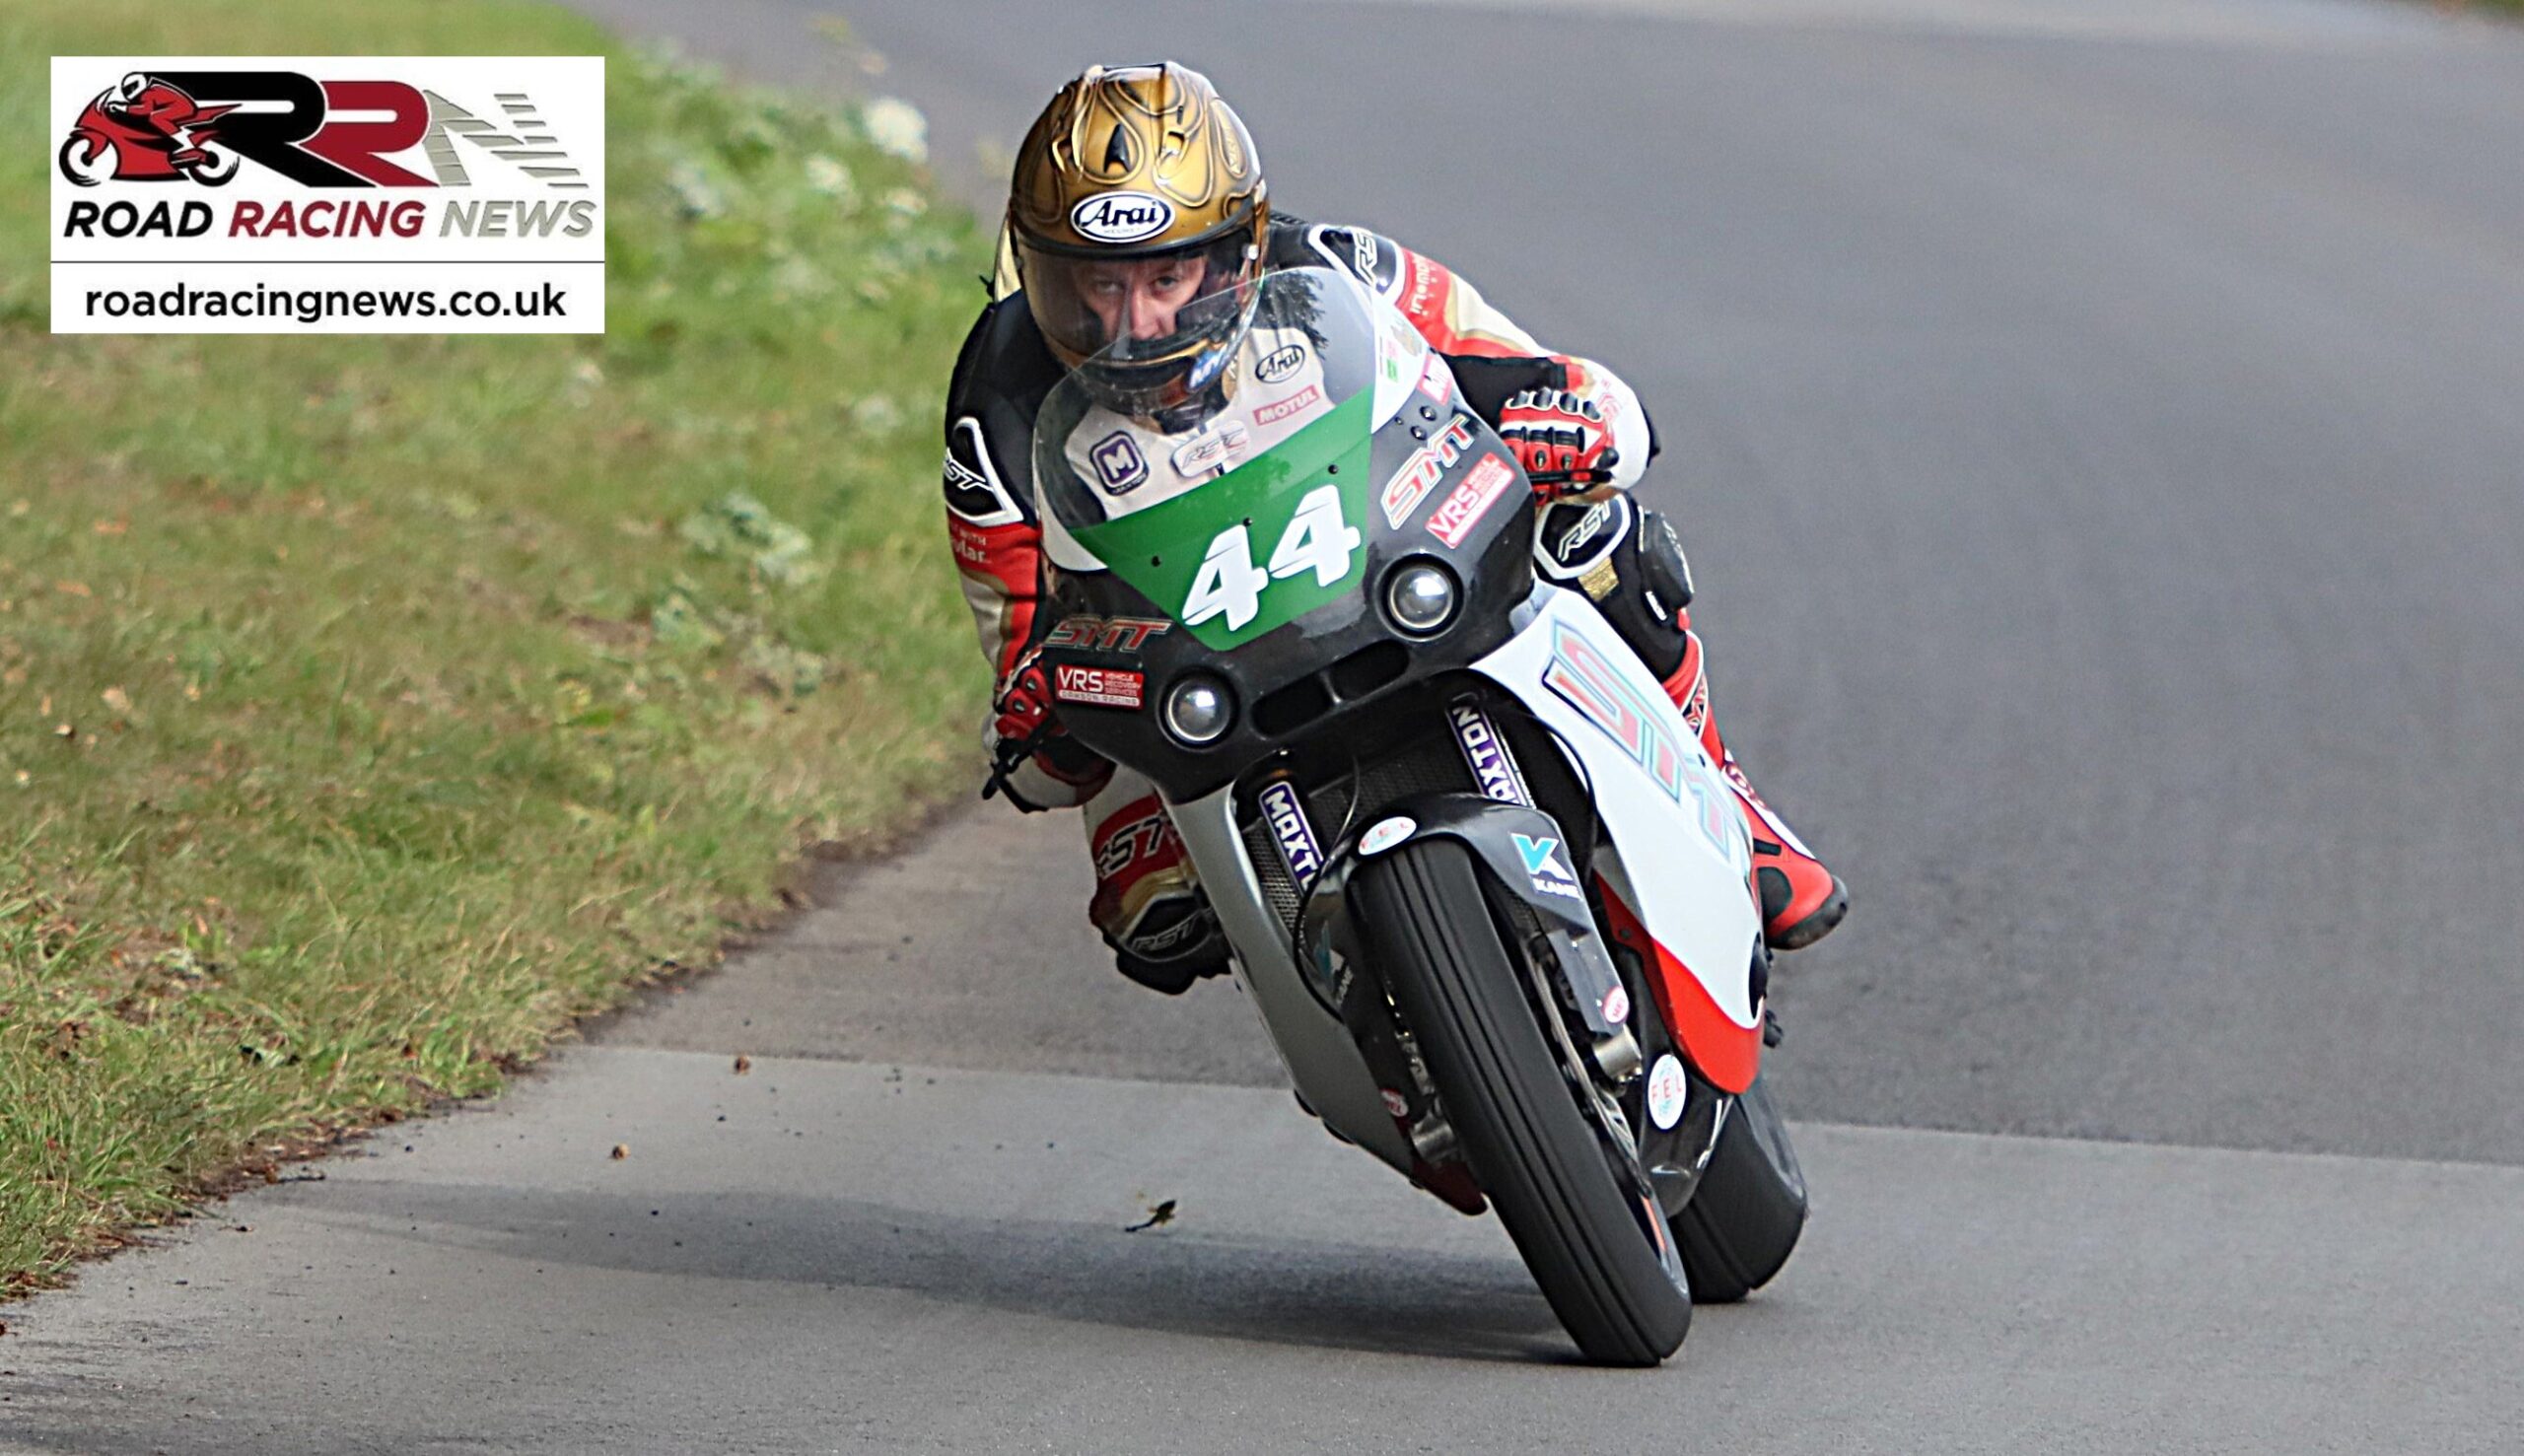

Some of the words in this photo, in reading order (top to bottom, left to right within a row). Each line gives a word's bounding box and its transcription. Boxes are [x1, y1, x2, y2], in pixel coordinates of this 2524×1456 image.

[1081, 200, 1157, 227] Arai
[1354, 230, 1379, 288] RS
[1259, 349, 1301, 380] Arai
[1258, 389, 1318, 424] MOTUL
[1381, 412, 1476, 530] SMT
[1427, 483, 1480, 535] VRS
[1182, 484, 1362, 632] 44
[1044, 613, 1174, 653] SMT
[1058, 667, 1104, 693] VRS
[1452, 705, 1519, 806] AXTON
